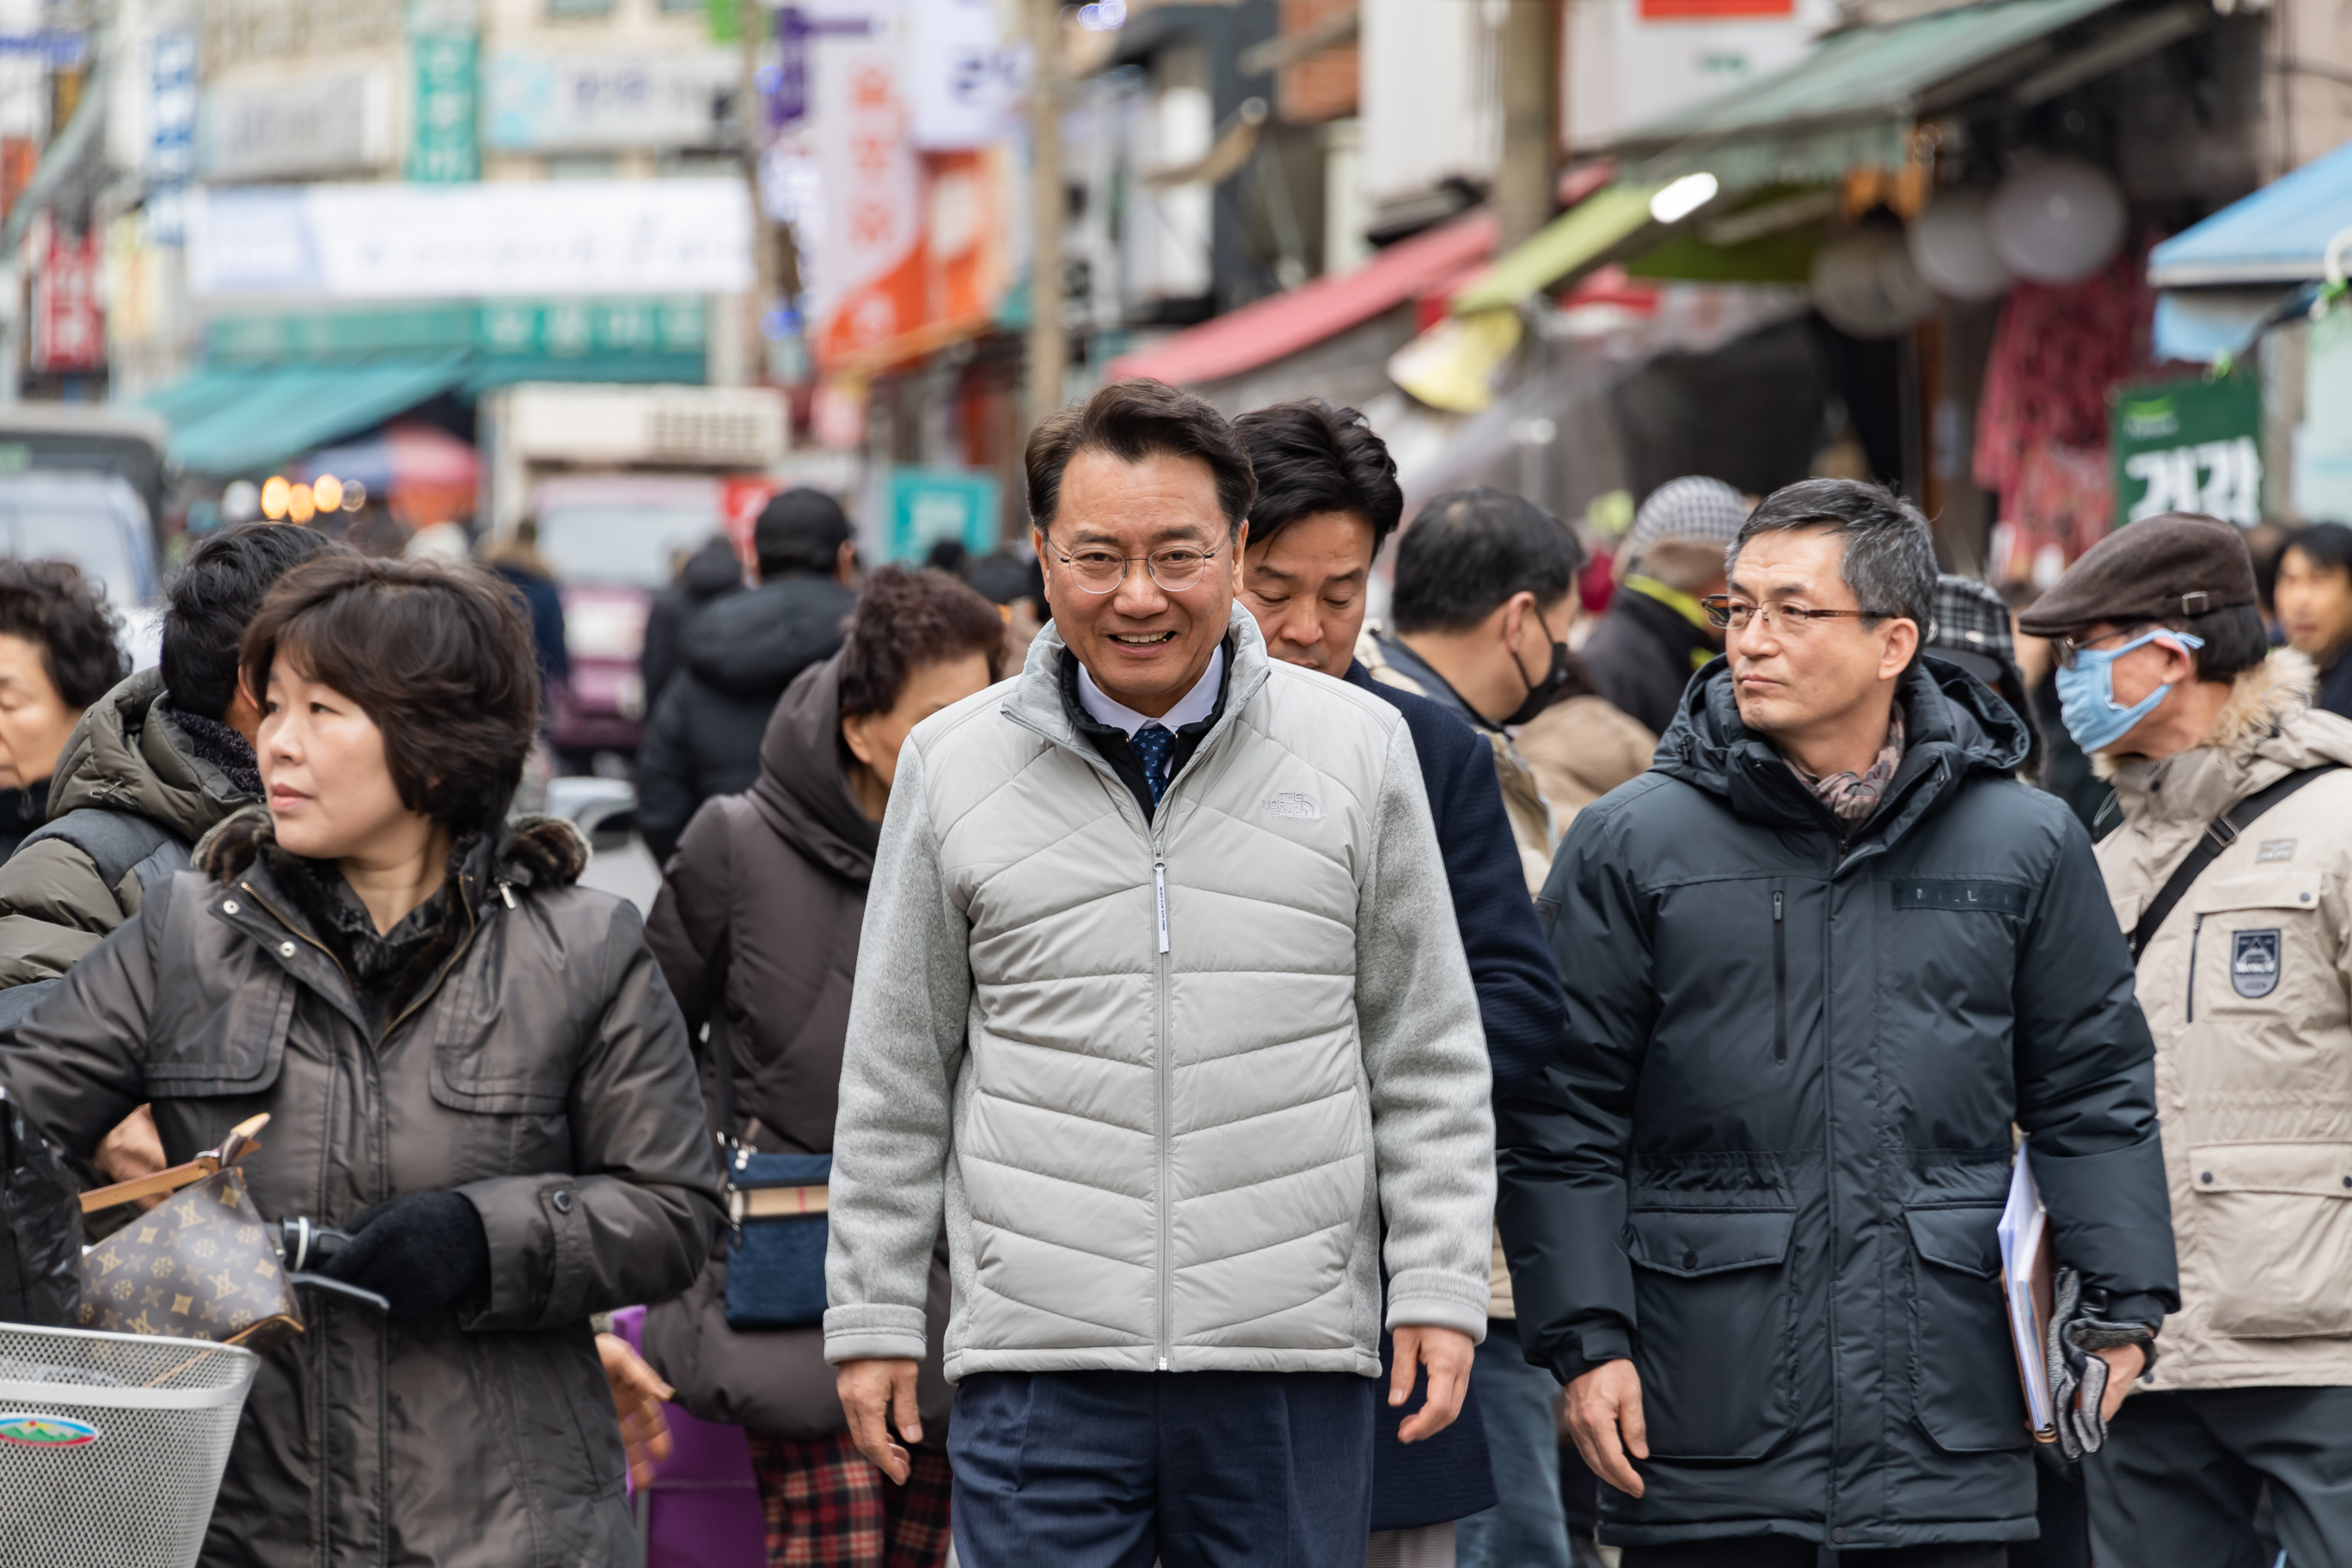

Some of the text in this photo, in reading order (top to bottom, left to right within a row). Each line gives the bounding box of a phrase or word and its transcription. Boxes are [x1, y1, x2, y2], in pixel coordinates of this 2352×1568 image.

[1279, 793, 1302, 802] THE
[1262, 799, 1302, 810] NORTH
[1272, 810, 1302, 818] FACE
